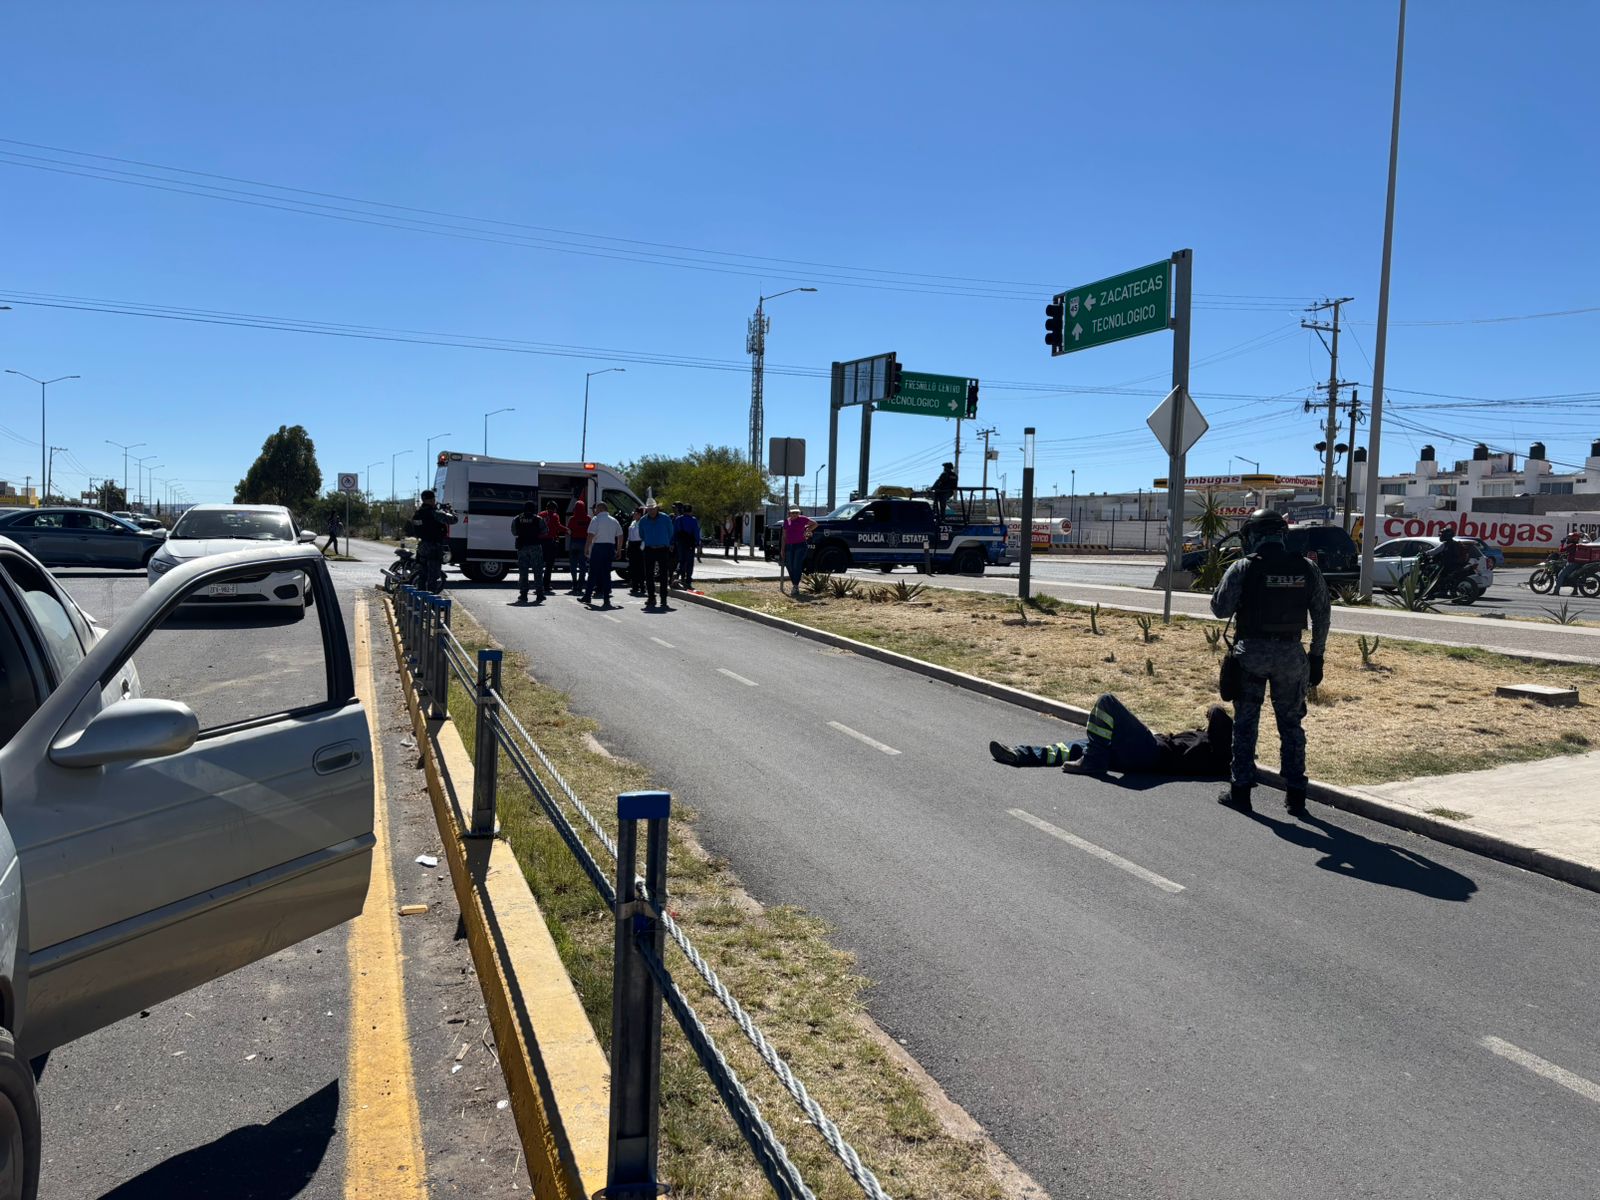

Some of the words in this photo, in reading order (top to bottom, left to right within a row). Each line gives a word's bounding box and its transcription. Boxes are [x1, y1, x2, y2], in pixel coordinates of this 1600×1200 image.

[1100, 275, 1163, 306] ZACATECAS
[1092, 304, 1156, 333] TECNOLOGICO
[905, 379, 936, 392] FRESNILLO
[937, 383, 961, 394] CENTRO
[1184, 476, 1239, 485] ombugas
[1281, 477, 1317, 486] combugas
[1008, 523, 1049, 533] cougas
[1384, 512, 1554, 546] combugas
[858, 532, 885, 543] POLICÍA
[1032, 534, 1049, 543] ERVICIO
